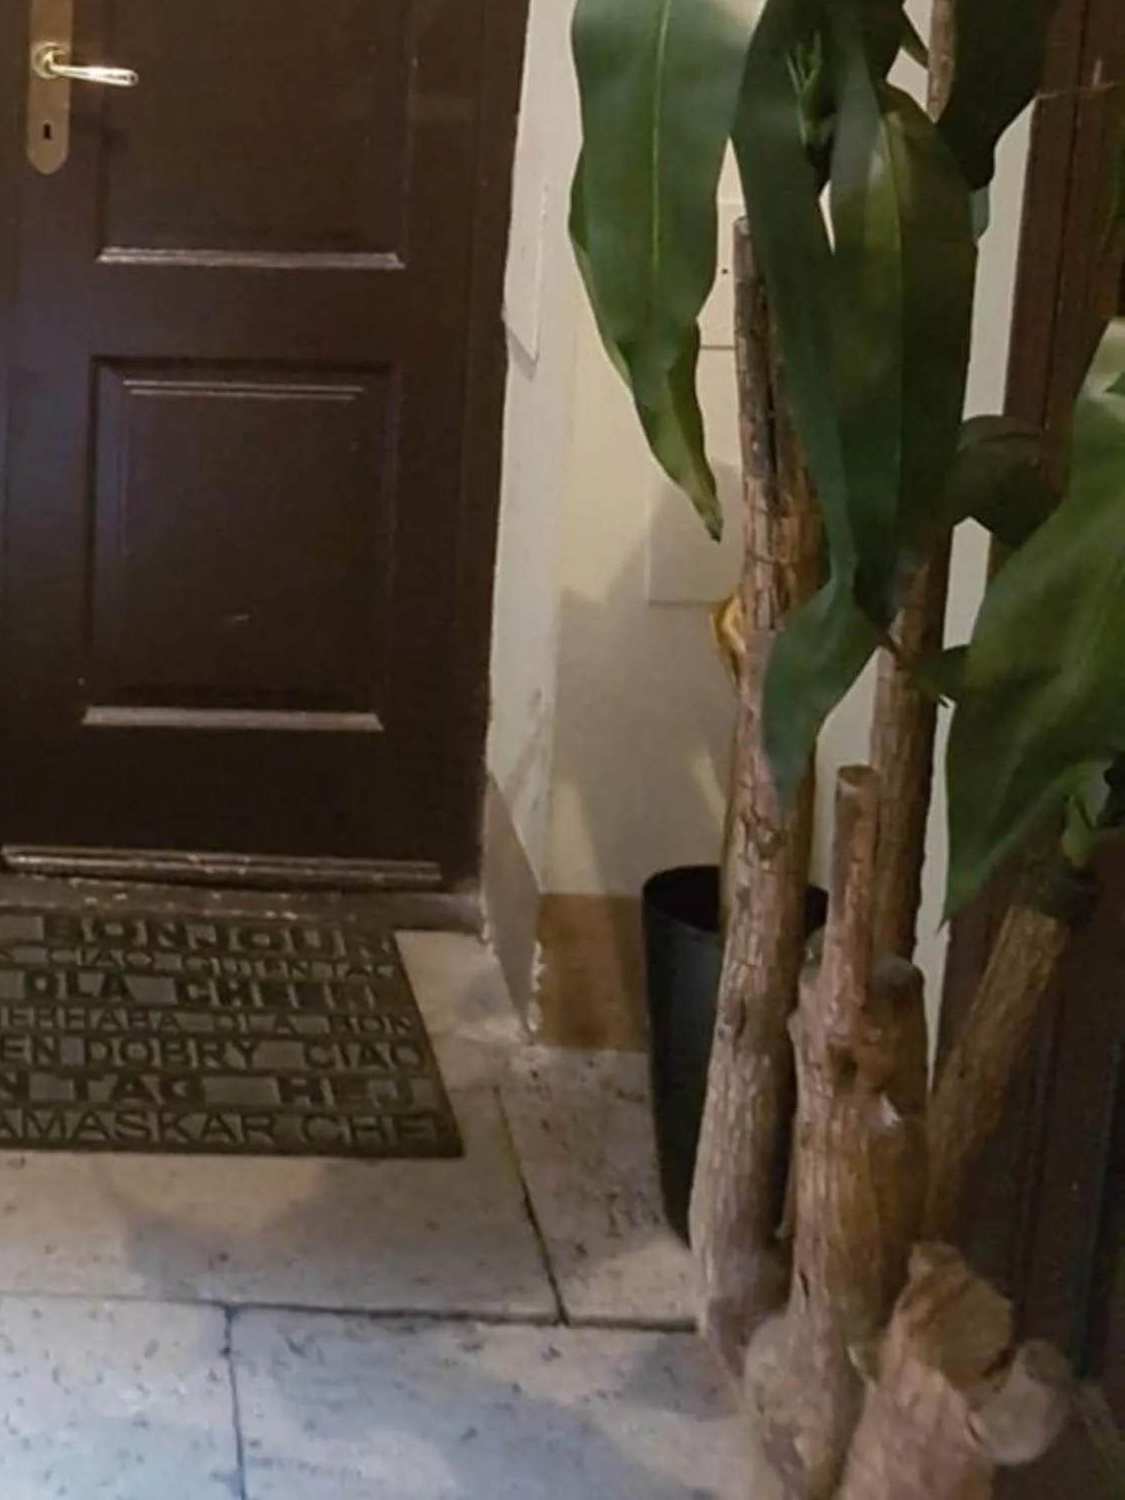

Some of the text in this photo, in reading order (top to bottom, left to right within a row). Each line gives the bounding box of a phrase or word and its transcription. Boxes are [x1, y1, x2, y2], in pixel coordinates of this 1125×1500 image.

[47, 946, 153, 971] CIAO
[24, 966, 132, 1000] OLA
[215, 1008, 297, 1037] OLA
[84, 1035, 262, 1070] DOBRY
[303, 1040, 428, 1073] CIAO
[59, 1068, 206, 1108] TAG
[277, 1074, 416, 1108] HEJ
